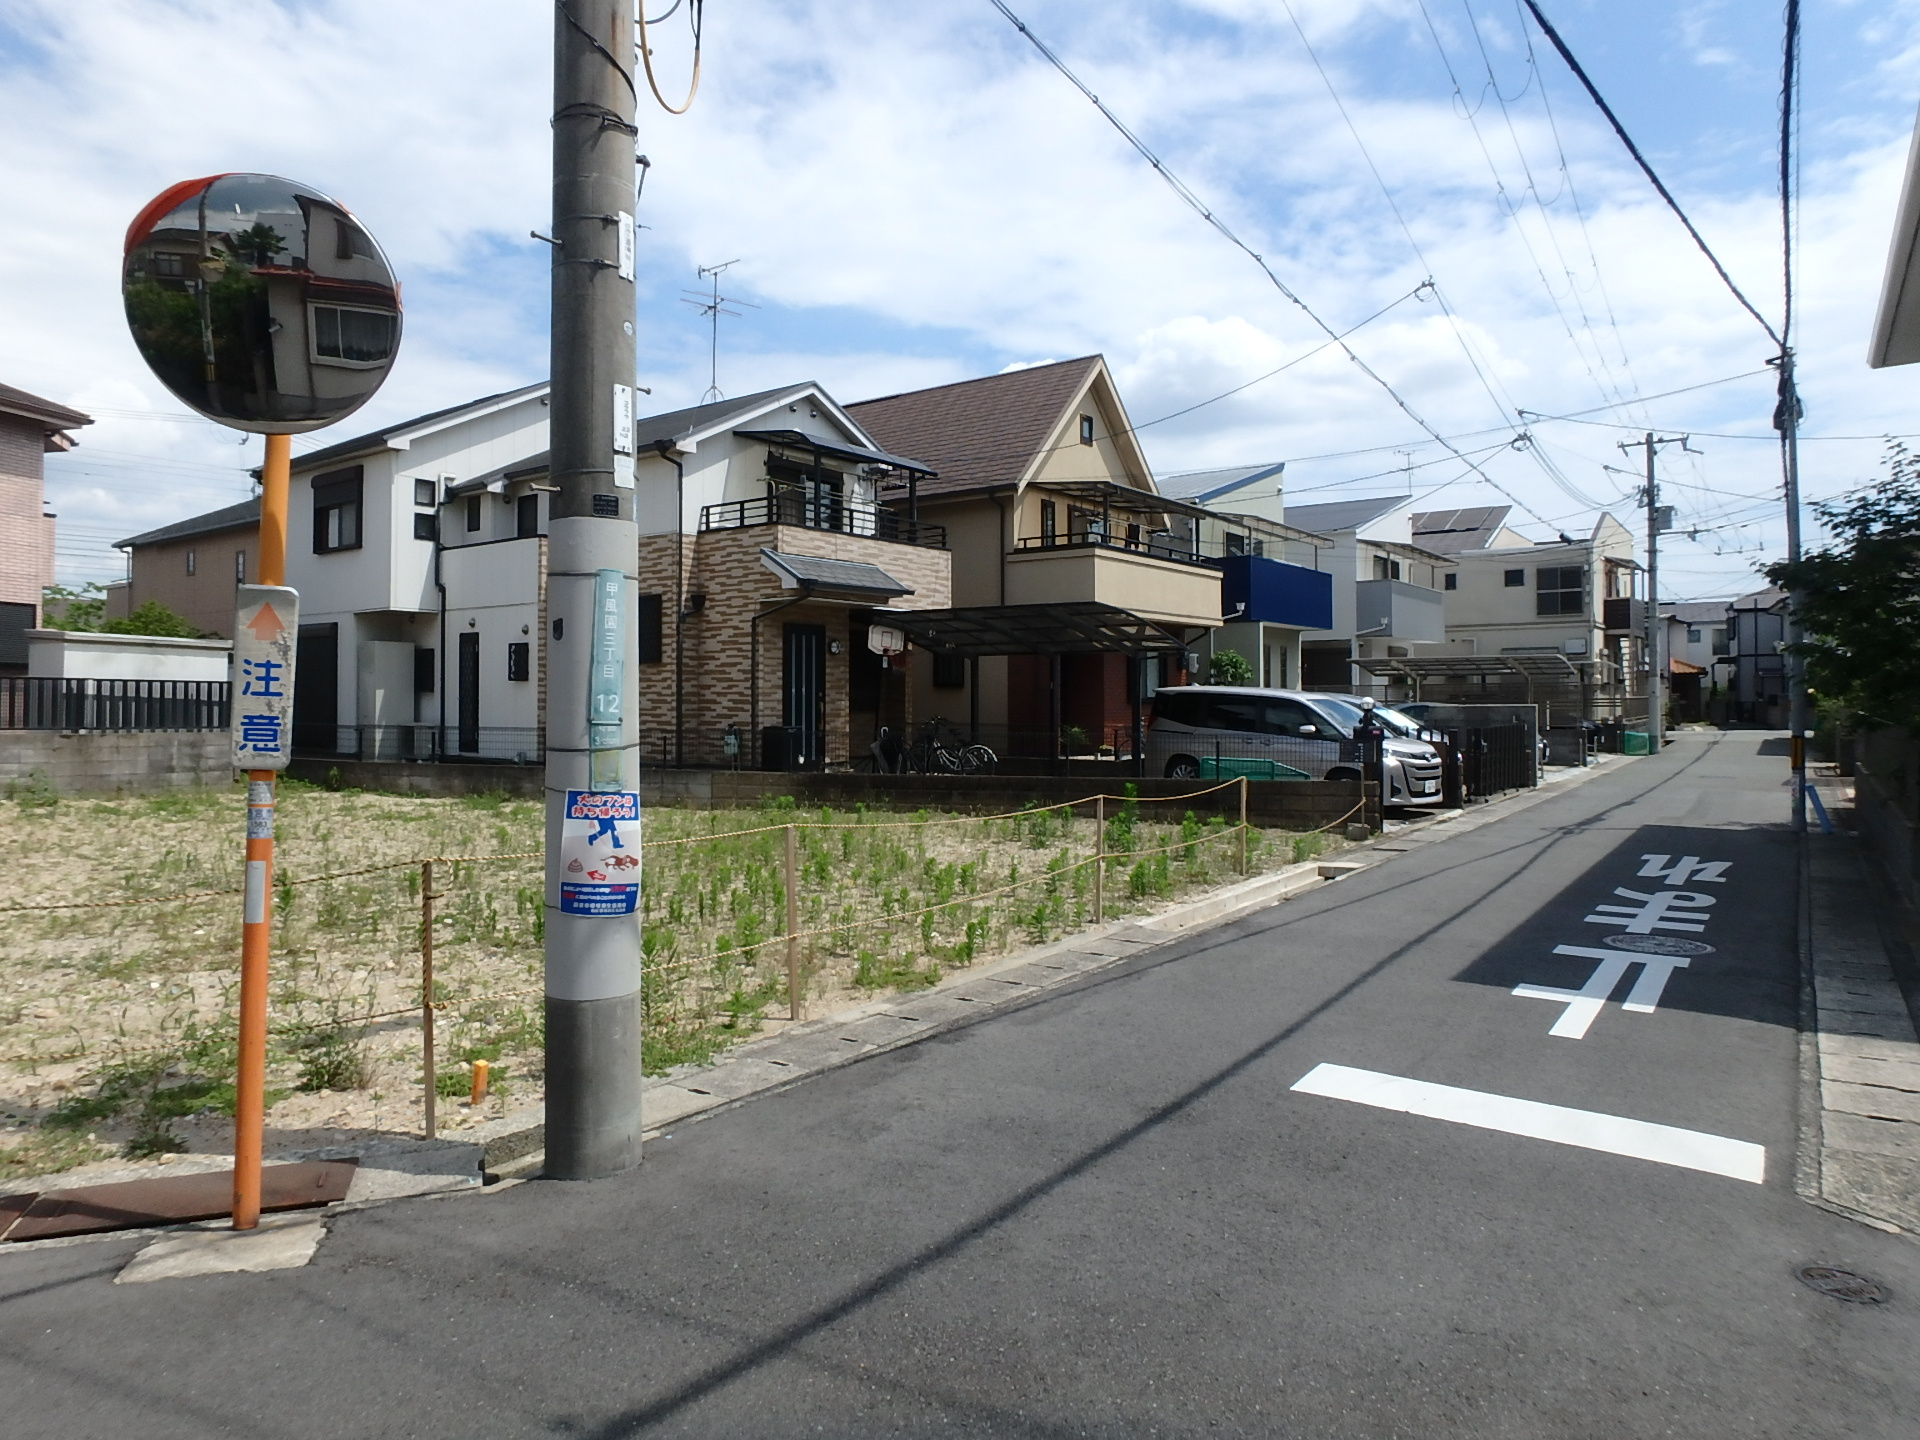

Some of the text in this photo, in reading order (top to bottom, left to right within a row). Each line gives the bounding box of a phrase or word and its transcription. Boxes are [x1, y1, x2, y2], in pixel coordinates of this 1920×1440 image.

[603, 582, 618, 678] 甲風園三丁目
[239, 658, 284, 753] 注意
[597, 694, 619, 714] 12
[577, 793, 634, 806] 犬のフンは
[1511, 854, 1733, 1040] 止まれ
